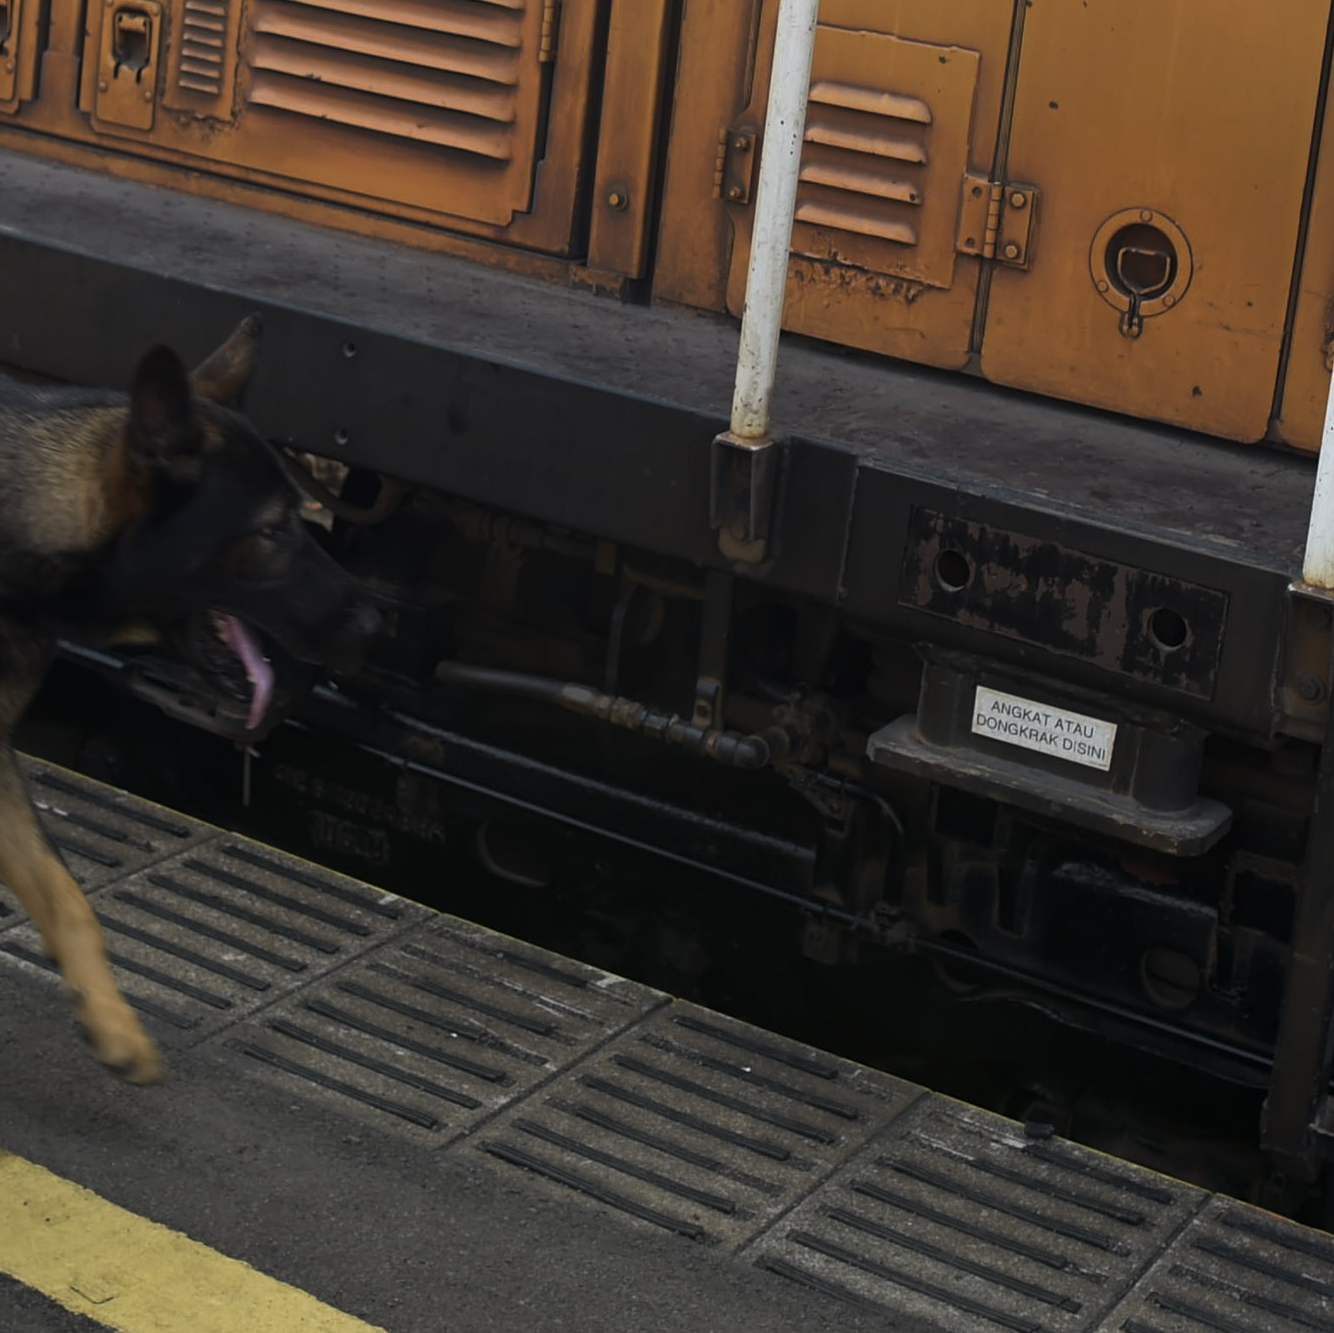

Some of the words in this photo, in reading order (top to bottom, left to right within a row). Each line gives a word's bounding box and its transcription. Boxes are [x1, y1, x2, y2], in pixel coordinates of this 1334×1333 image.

[976, 713, 1059, 746] DONGKRAK
[1062, 738, 1106, 760] DISINI
[991, 700, 1052, 726] ANGKAT
[1054, 718, 1094, 739] ATAU
